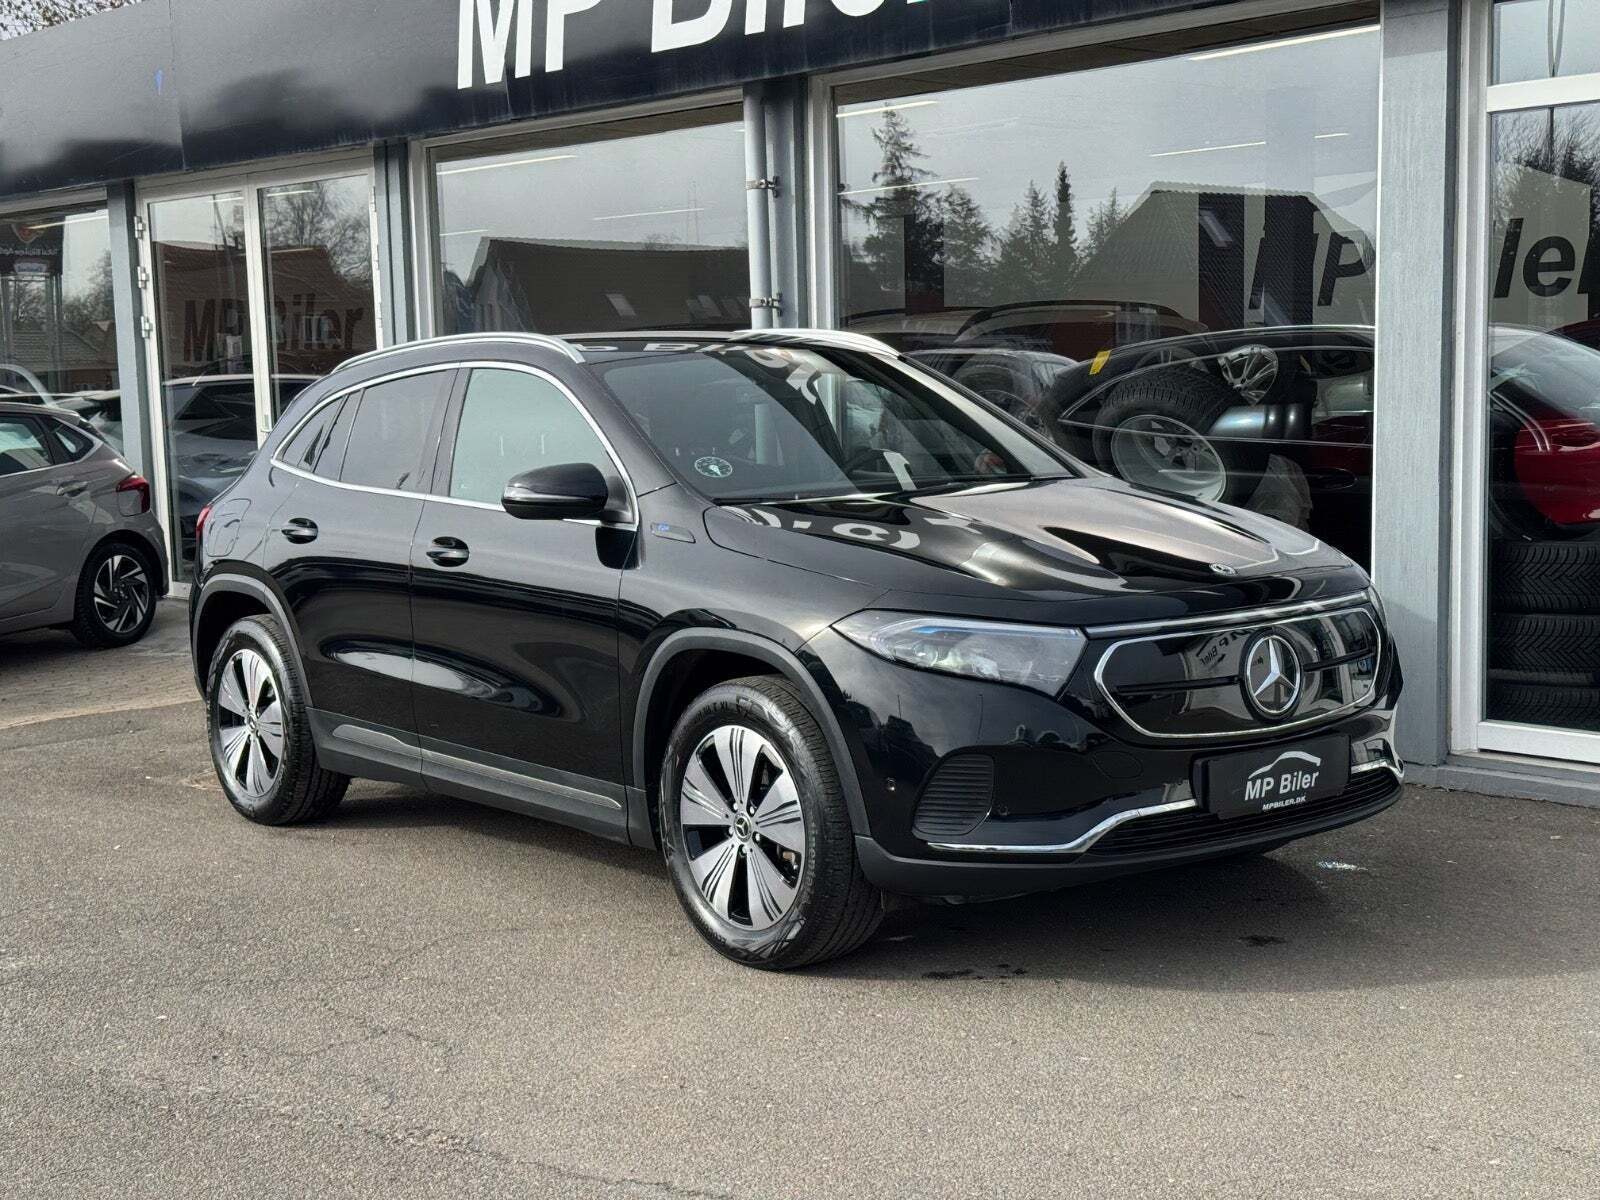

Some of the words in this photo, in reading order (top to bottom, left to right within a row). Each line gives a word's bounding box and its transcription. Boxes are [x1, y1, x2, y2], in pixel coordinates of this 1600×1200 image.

[1244, 778, 1275, 801] MP
[1280, 770, 1319, 794] Biler
[1262, 795, 1307, 811] MPBILER.DK
